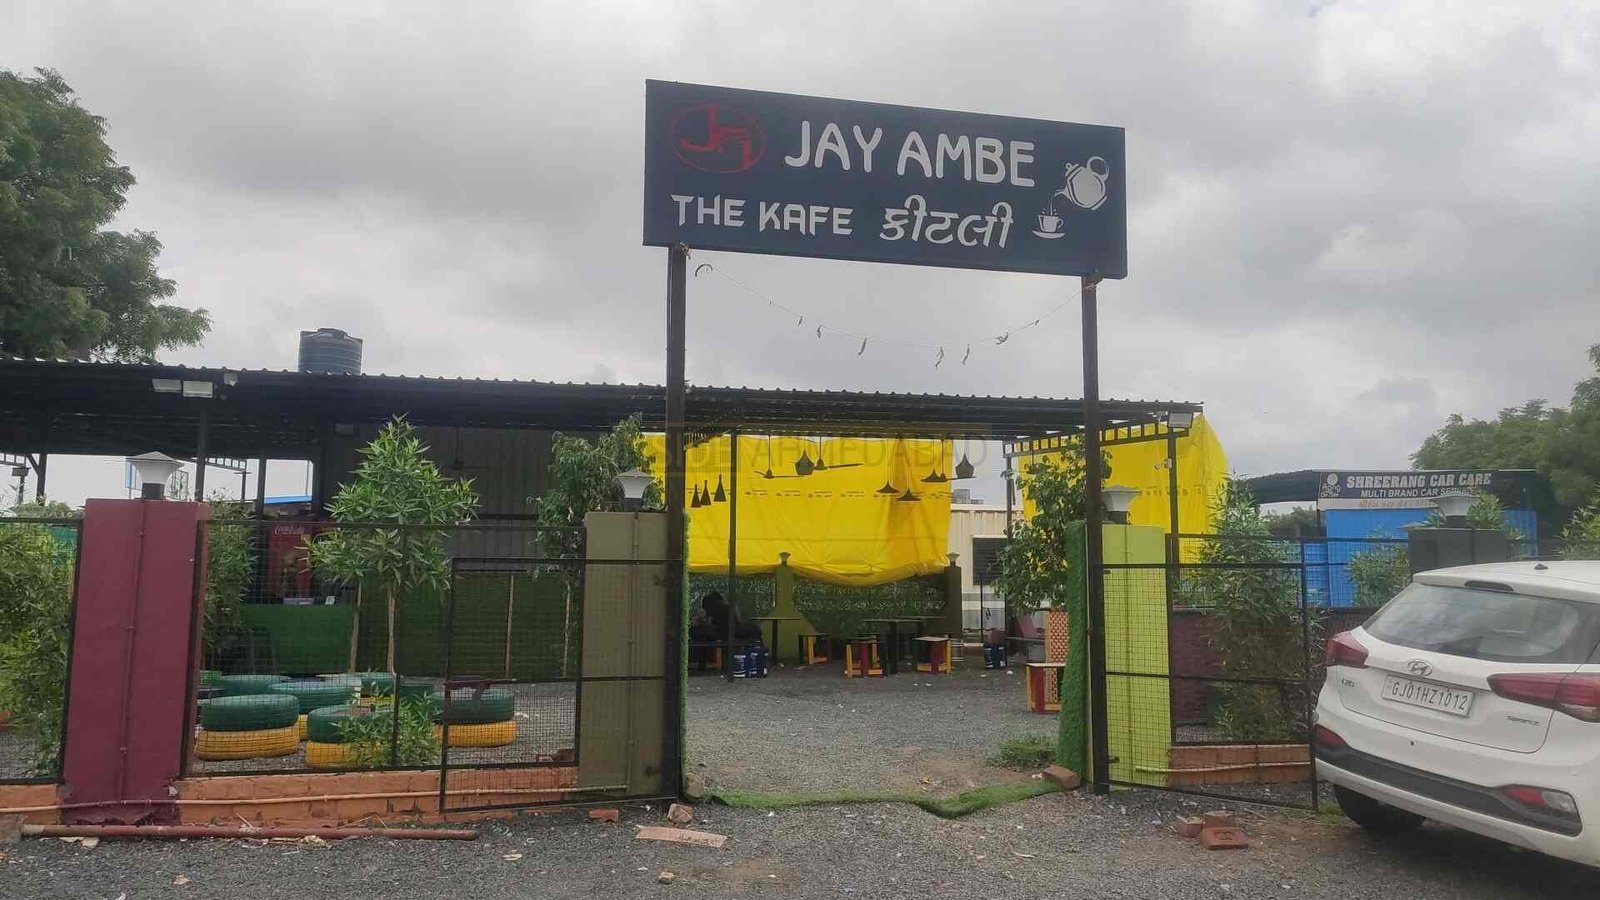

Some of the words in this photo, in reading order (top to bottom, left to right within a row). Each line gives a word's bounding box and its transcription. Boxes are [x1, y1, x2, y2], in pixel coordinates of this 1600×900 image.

[784, 120, 883, 173] JAY
[896, 131, 1036, 188] AMBE
[671, 194, 745, 227] THE
[759, 201, 853, 236] KAFE
[880, 194, 1014, 249] કીટલી
[1346, 475, 1426, 489] SHREERANG
[1429, 474, 1455, 487] CAR
[1458, 473, 1492, 486] CARE
[1360, 488, 1387, 498] MULTI
[1388, 488, 1419, 498] BRAND
[1420, 487, 1439, 497] CAR
[1391, 681, 1468, 710] GJ01HZ1012
